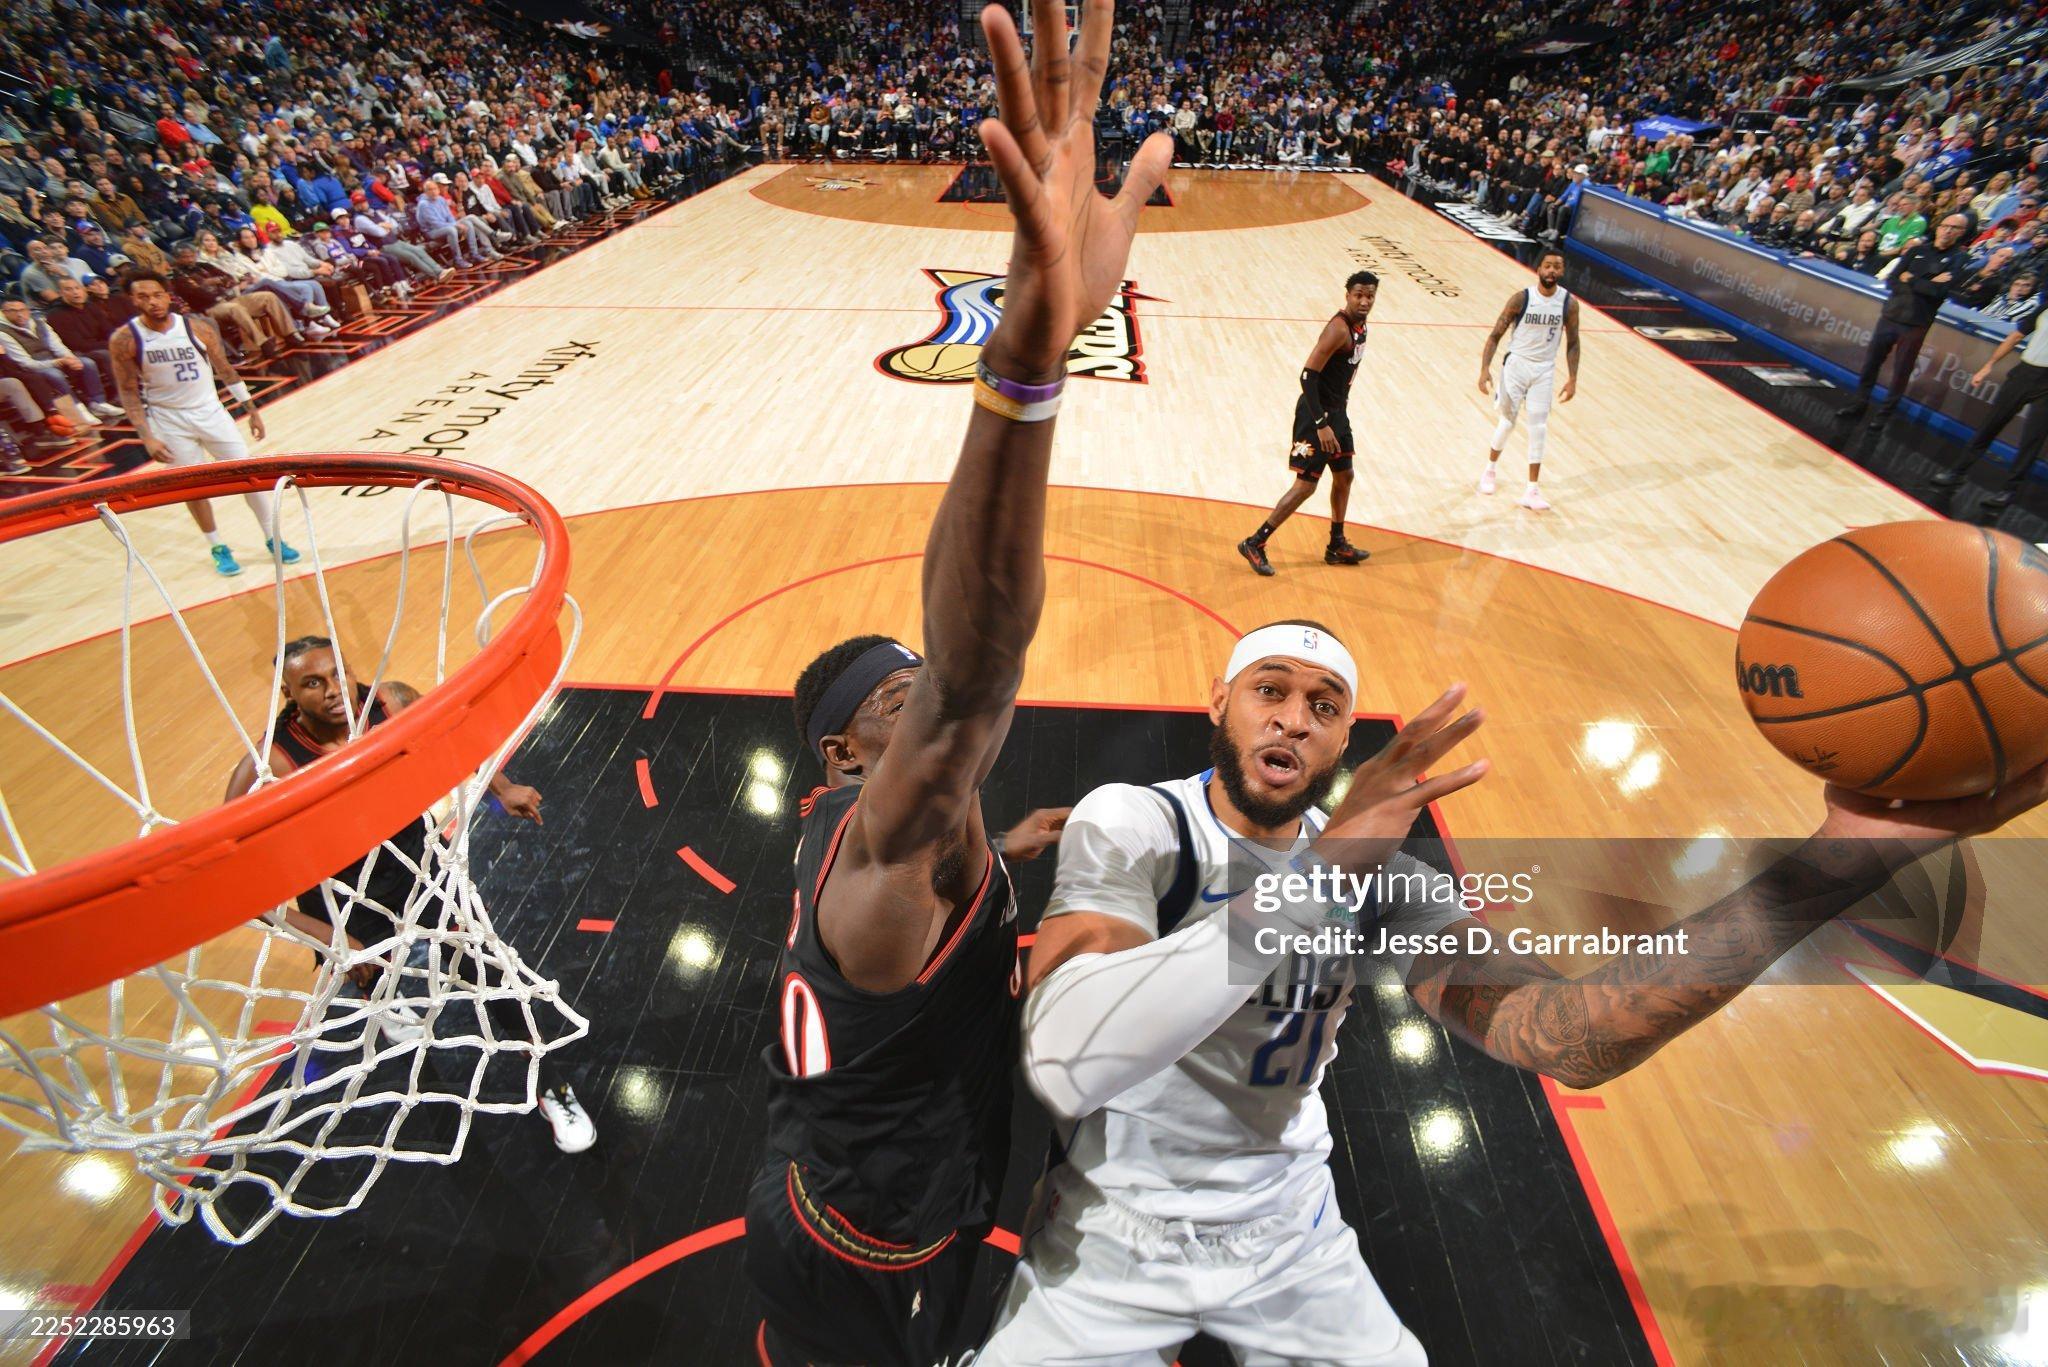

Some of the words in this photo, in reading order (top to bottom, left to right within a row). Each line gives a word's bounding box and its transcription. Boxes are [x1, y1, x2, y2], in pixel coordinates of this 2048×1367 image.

[1692, 256, 1737, 284] Official
[1738, 274, 1815, 323] Healthcare
[1815, 306, 1873, 348] Partne
[1524, 313, 1562, 326] DALLAS
[1547, 327, 1558, 342] 5
[146, 347, 196, 364] DALLAS
[174, 362, 200, 383] 25
[1248, 1010, 1329, 1086] 21
